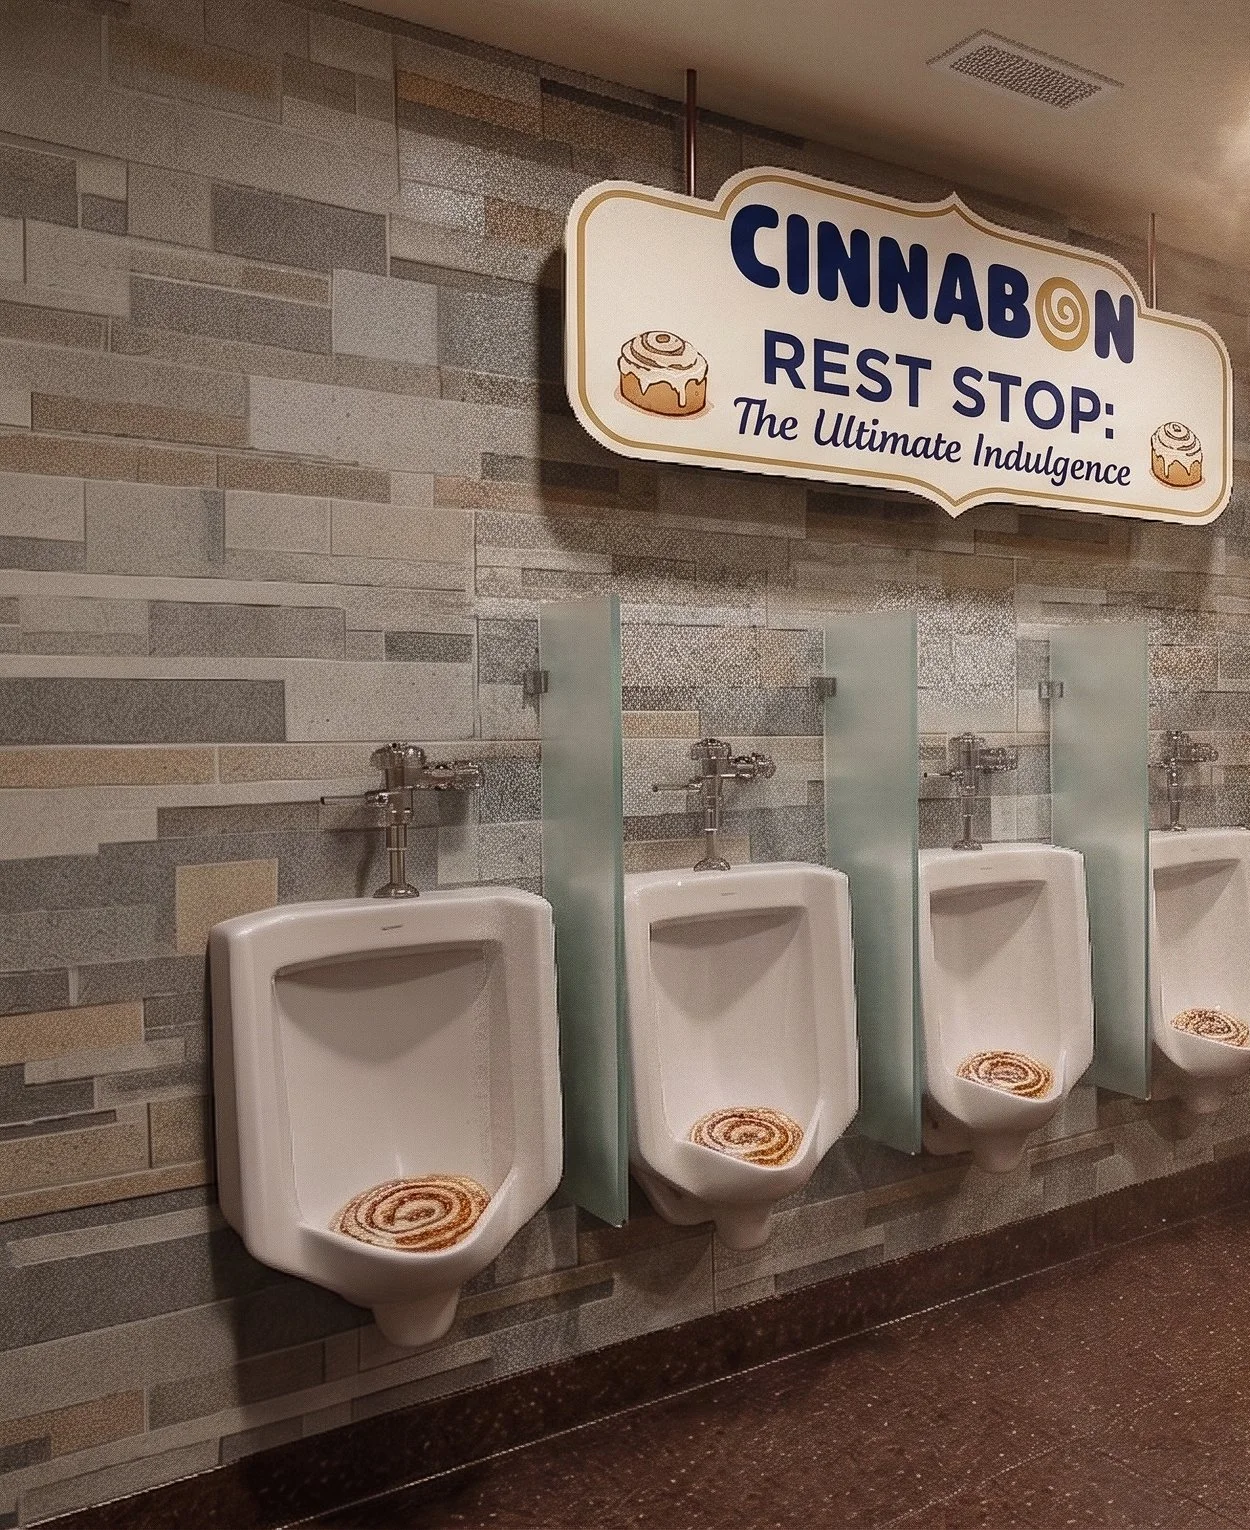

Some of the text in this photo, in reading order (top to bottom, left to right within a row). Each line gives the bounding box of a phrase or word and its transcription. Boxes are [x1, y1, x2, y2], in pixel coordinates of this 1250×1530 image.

[730, 203, 1135, 364] CINNABON
[764, 329, 1115, 439] REST STOP:
[733, 396, 1132, 493] The Ultimate Indulgence
